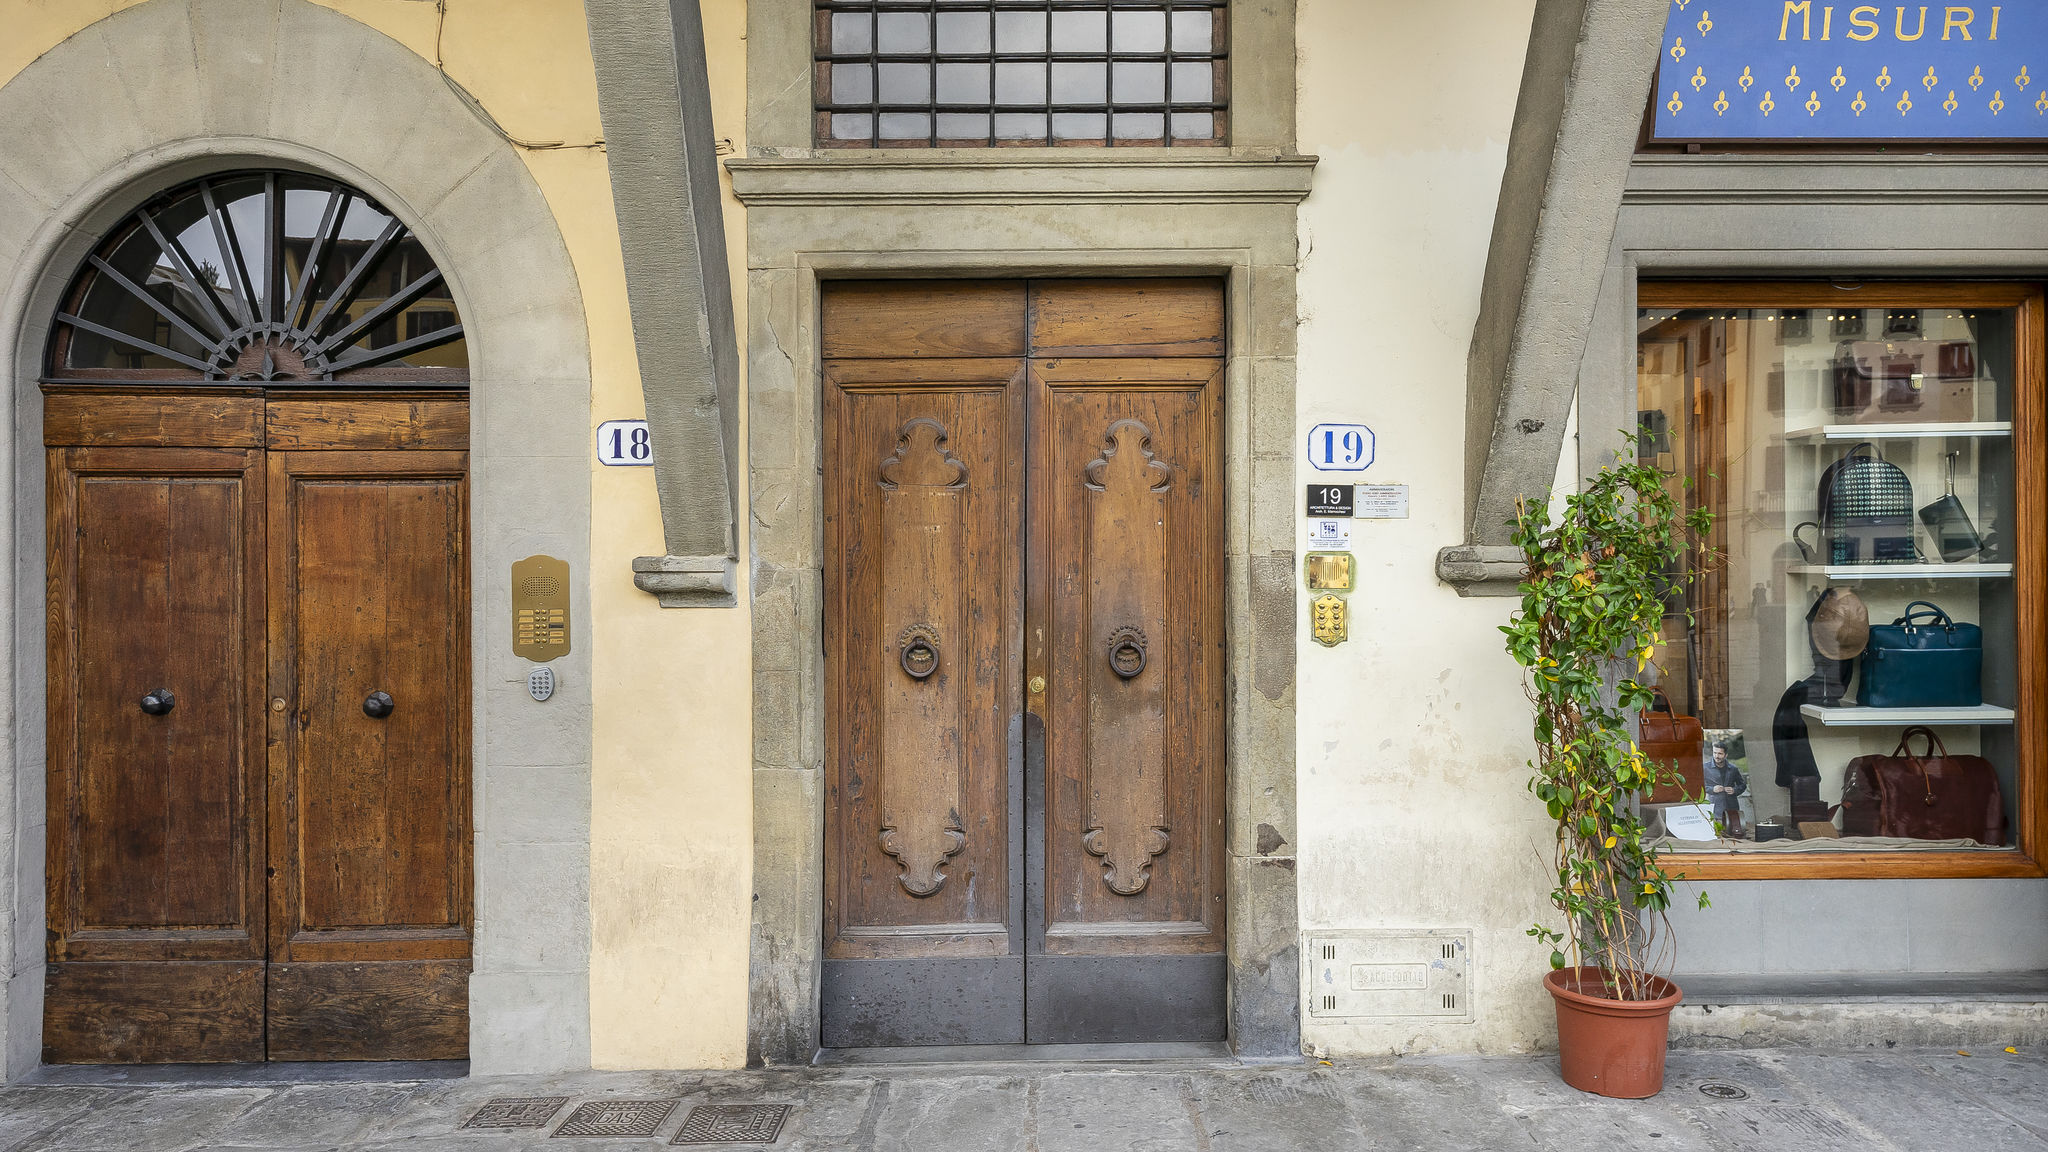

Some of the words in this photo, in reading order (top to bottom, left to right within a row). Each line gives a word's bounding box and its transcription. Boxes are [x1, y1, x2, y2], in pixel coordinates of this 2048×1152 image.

[1778, 1, 2001, 41] MISURI
[609, 428, 650, 460] 18
[1322, 430, 1363, 464] 19
[1320, 487, 1341, 504] 19
[596, 1111, 638, 1124] GAS
